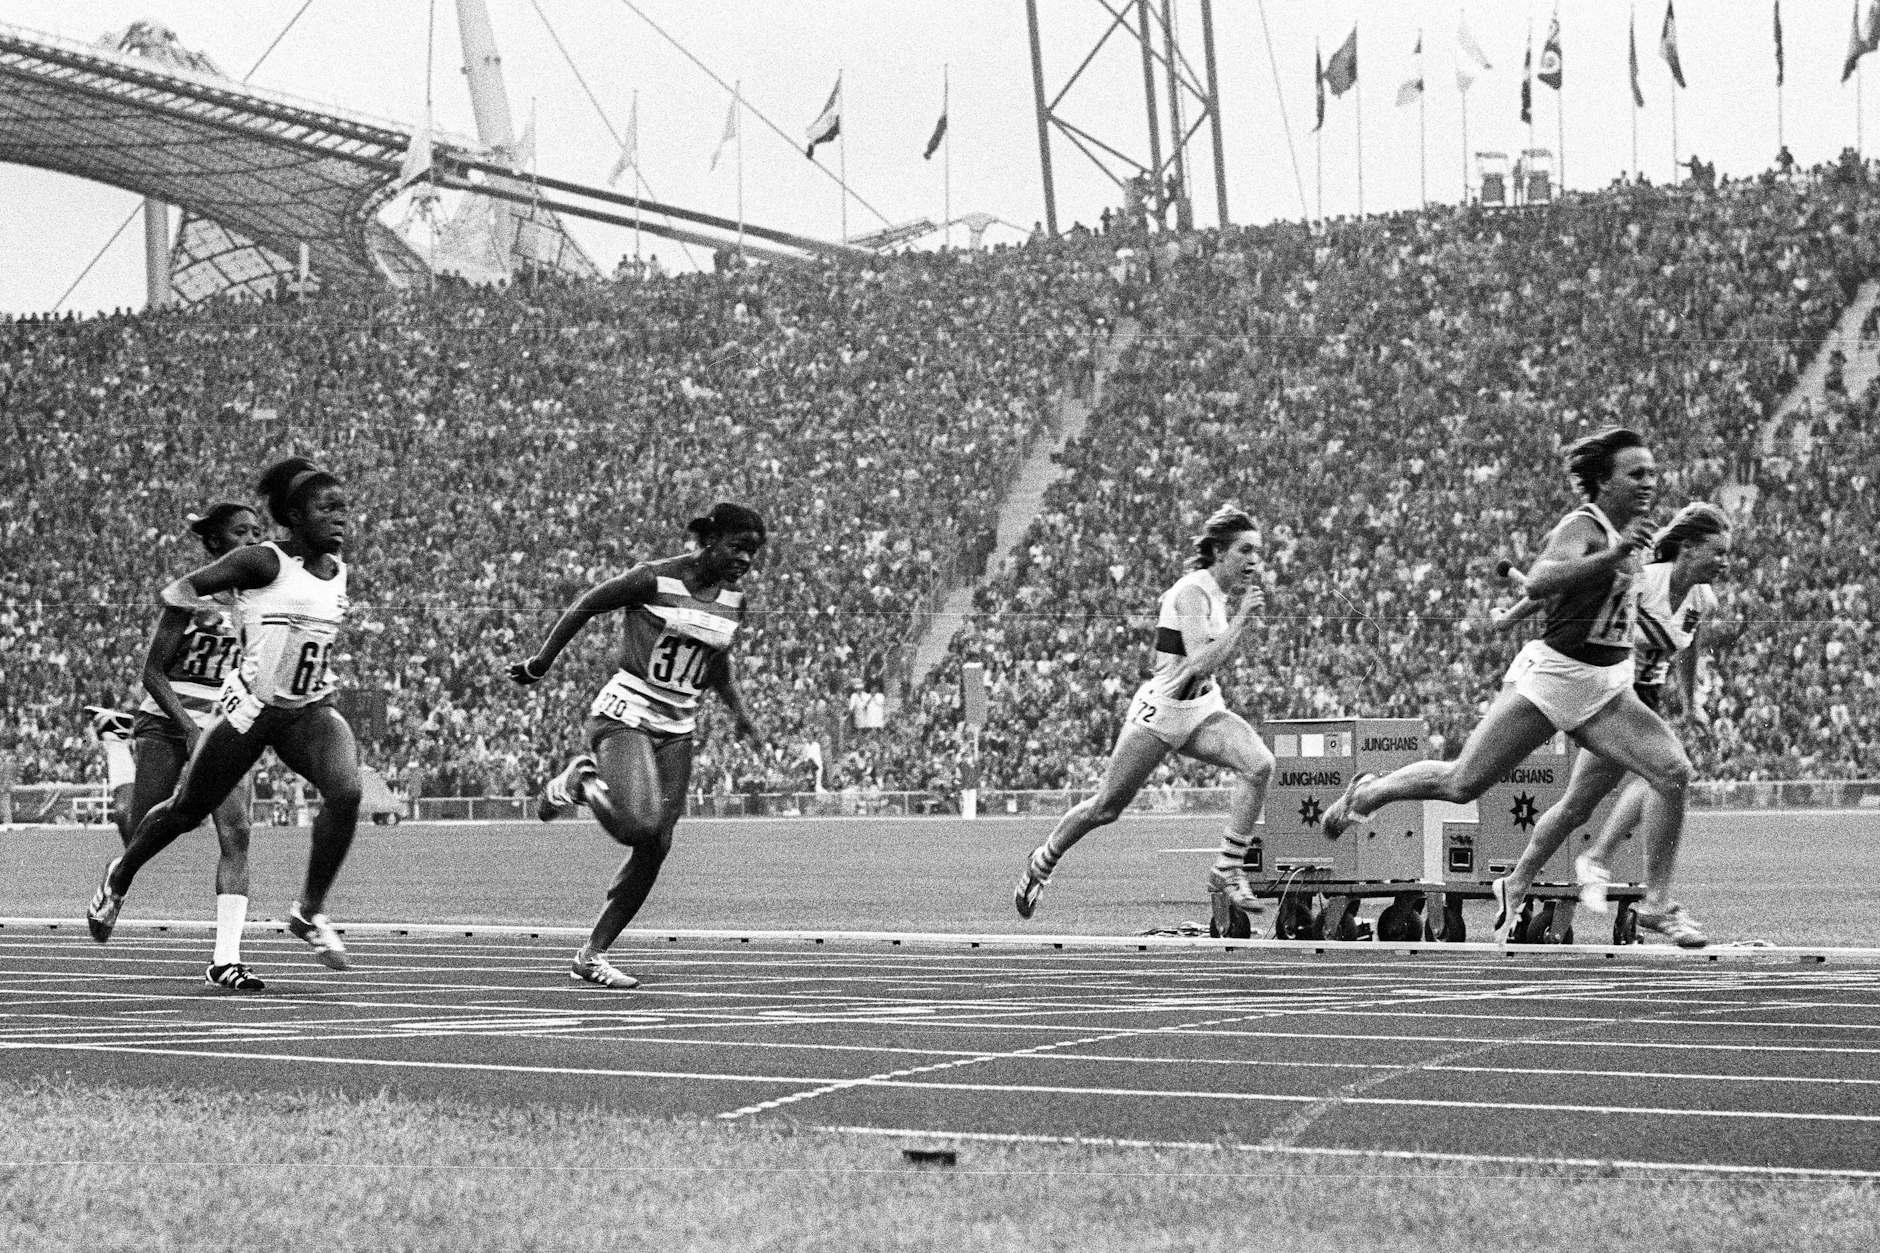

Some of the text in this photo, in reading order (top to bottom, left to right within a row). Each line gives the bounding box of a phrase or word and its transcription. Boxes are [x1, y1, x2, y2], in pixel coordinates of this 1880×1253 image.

[1361, 736, 1418, 752] JUNGHANS
[1278, 771, 1341, 786] JUNGHANS
[1501, 769, 1554, 784] UNGHANS
